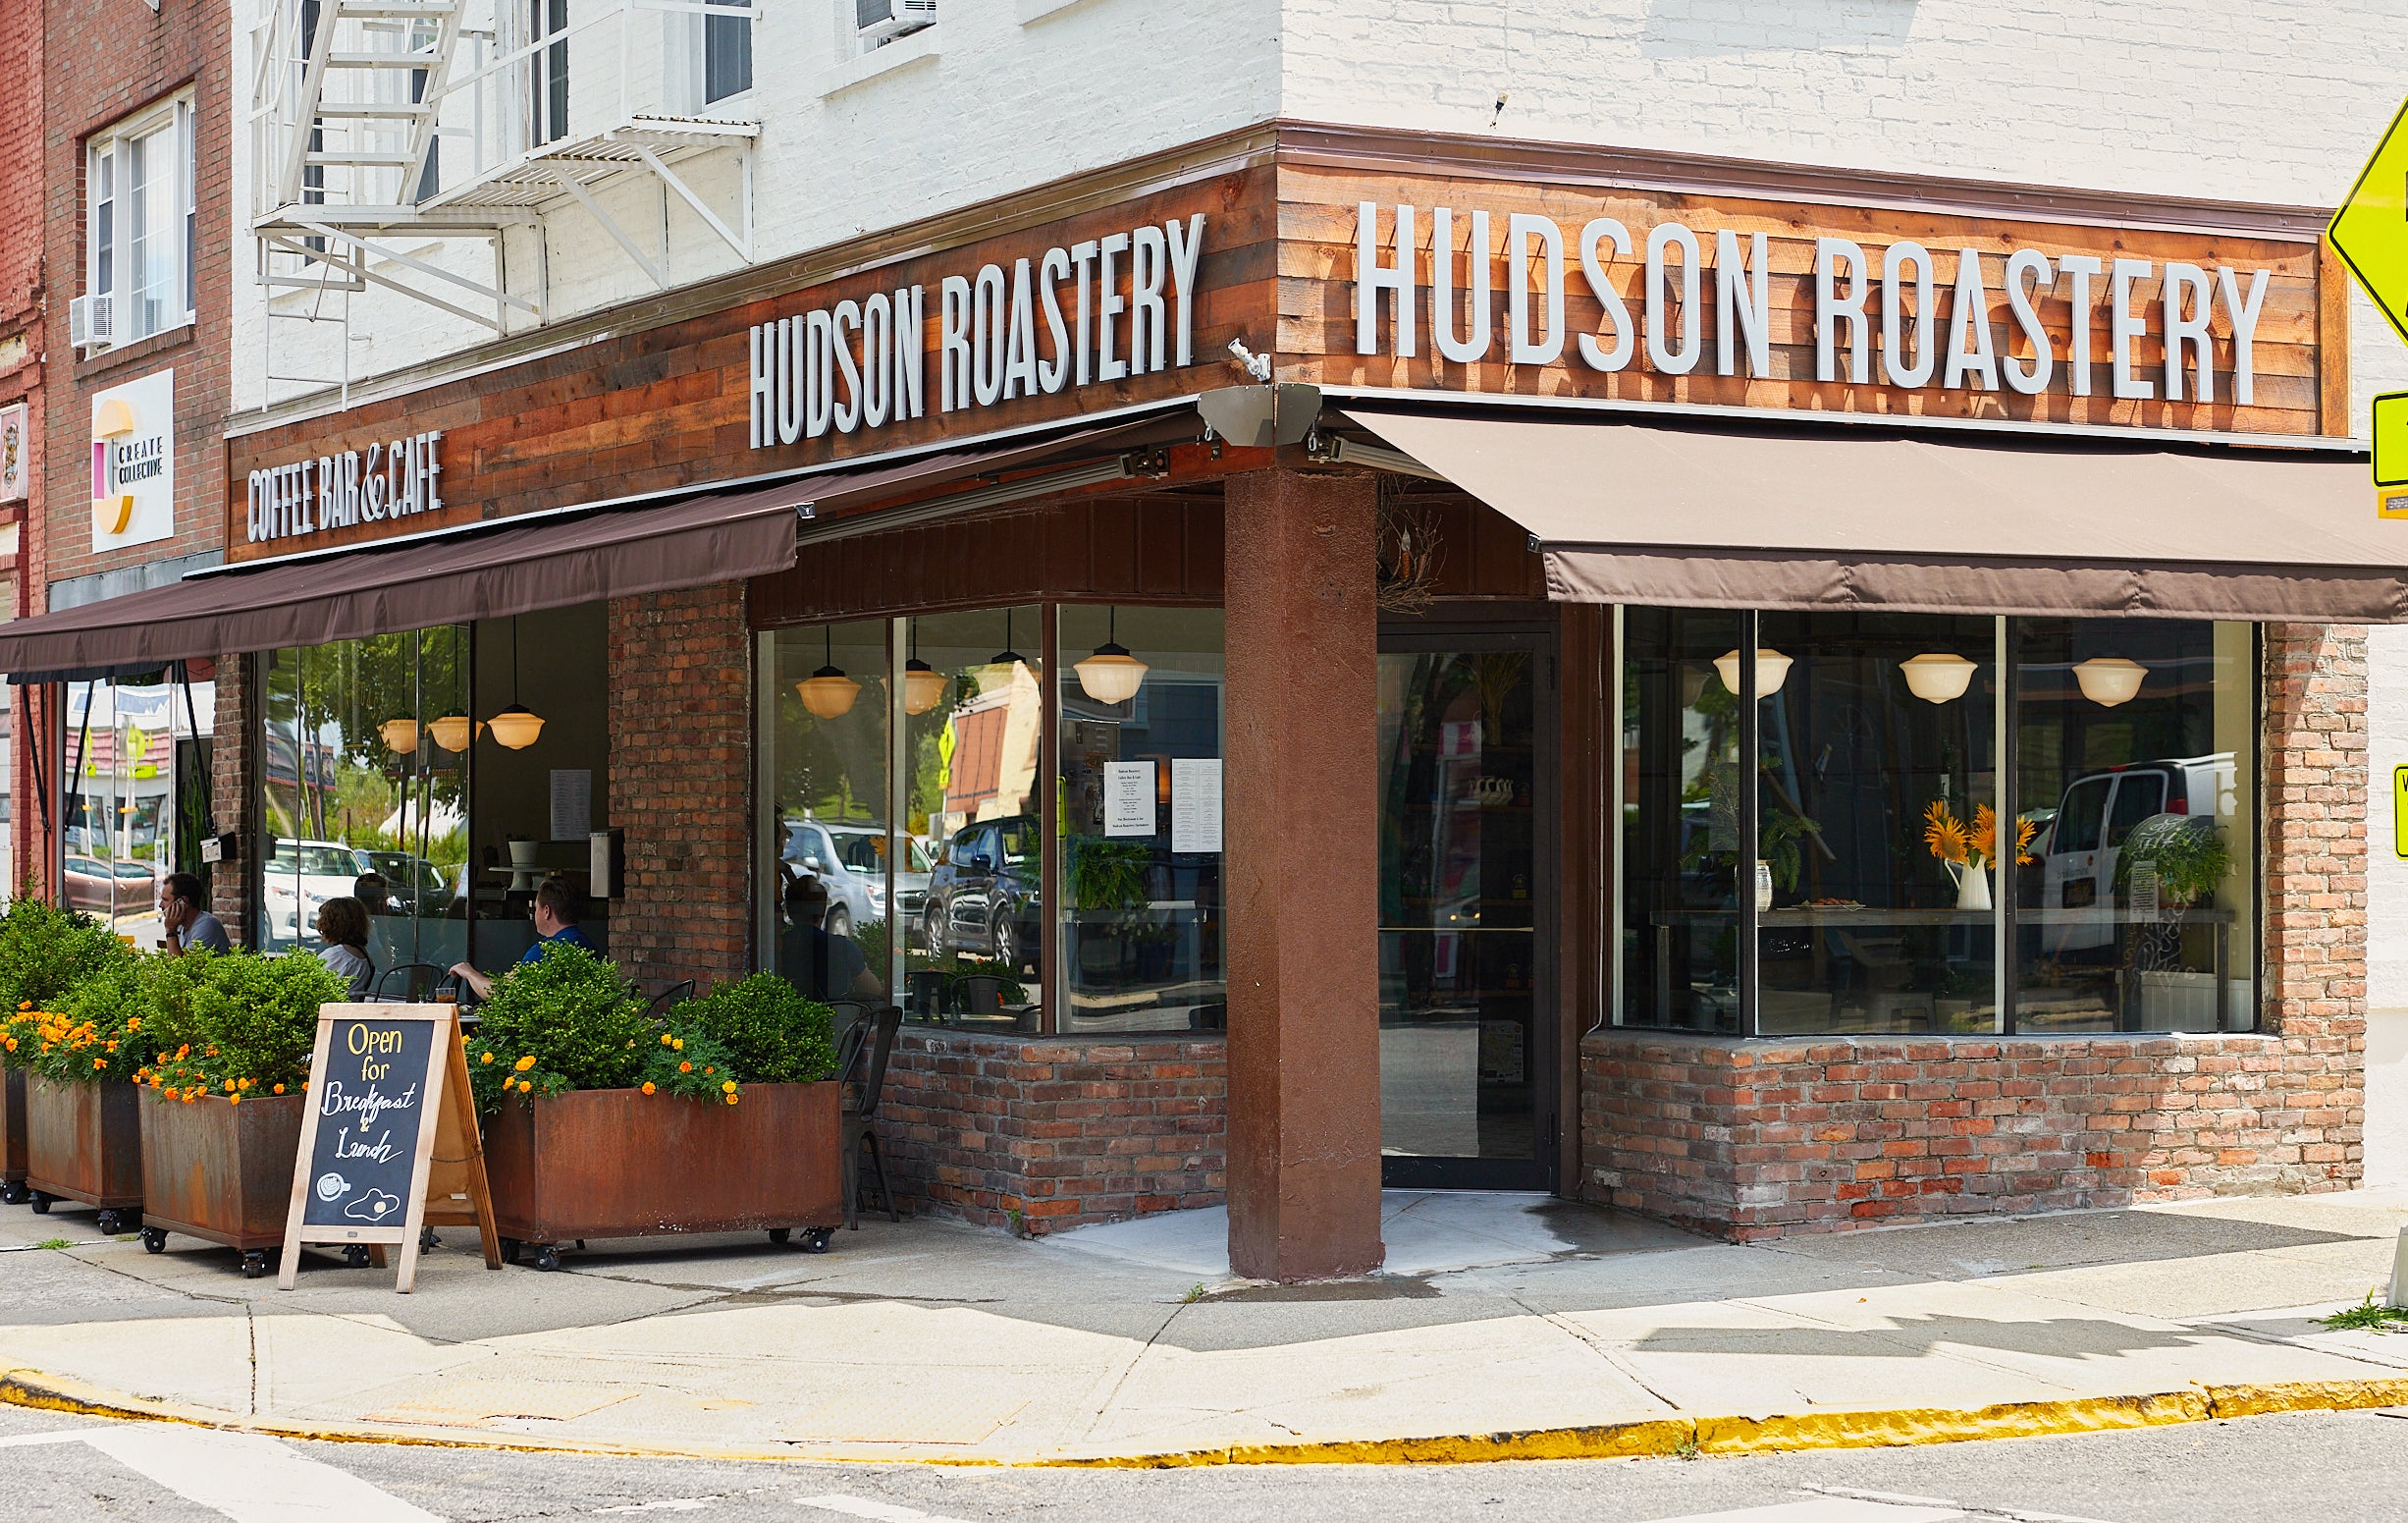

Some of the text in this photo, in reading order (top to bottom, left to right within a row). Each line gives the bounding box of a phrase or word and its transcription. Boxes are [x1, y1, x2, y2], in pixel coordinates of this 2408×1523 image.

[1357, 200, 2272, 406] HUDSON ROASTERY
[750, 212, 1205, 450] HUDSON ROASTERY
[119, 436, 163, 464] CREATE
[119, 457, 163, 485] COLLECTIVE
[247, 430, 442, 543] COFFEE BAR & CAFE
[348, 1022, 402, 1056] Open
[360, 1055, 391, 1082] for
[321, 1080, 417, 1124] Breakfast
[359, 1116, 370, 1133] &
[335, 1126, 404, 1165] Lunch
